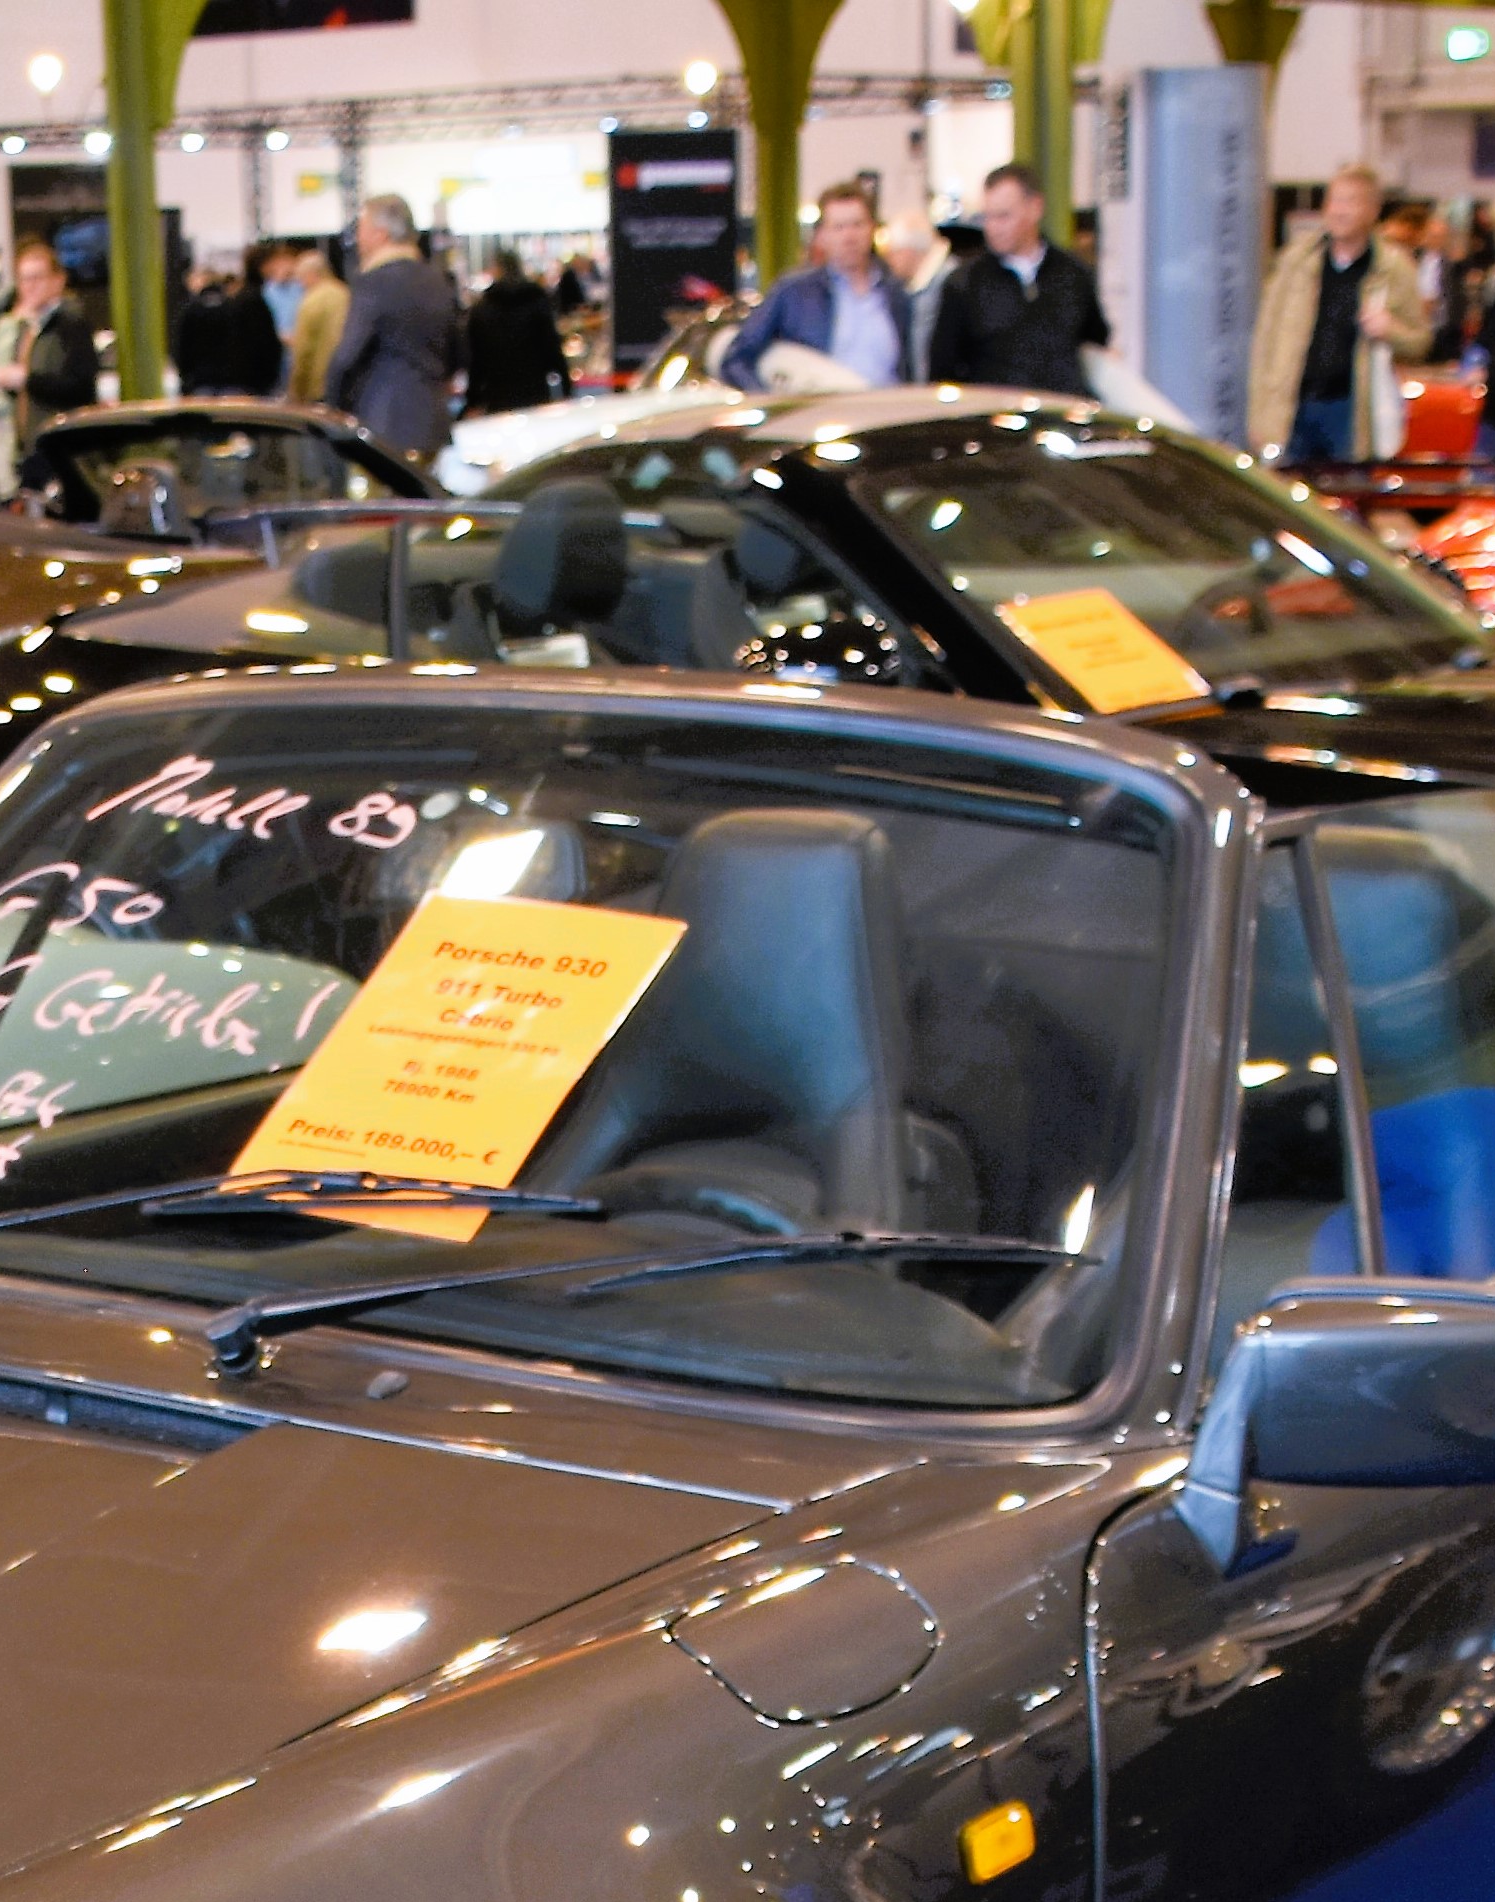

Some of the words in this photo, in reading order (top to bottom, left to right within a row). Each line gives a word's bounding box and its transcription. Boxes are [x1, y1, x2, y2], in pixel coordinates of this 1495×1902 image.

[327, 790, 417, 849] 89
[48, 875, 164, 935] 50
[433, 940, 547, 971] Porsche
[552, 955, 609, 980] 930
[433, 978, 482, 1000] 911
[491, 985, 564, 1010] Turbo
[287, 1118, 355, 1142] Preis:
